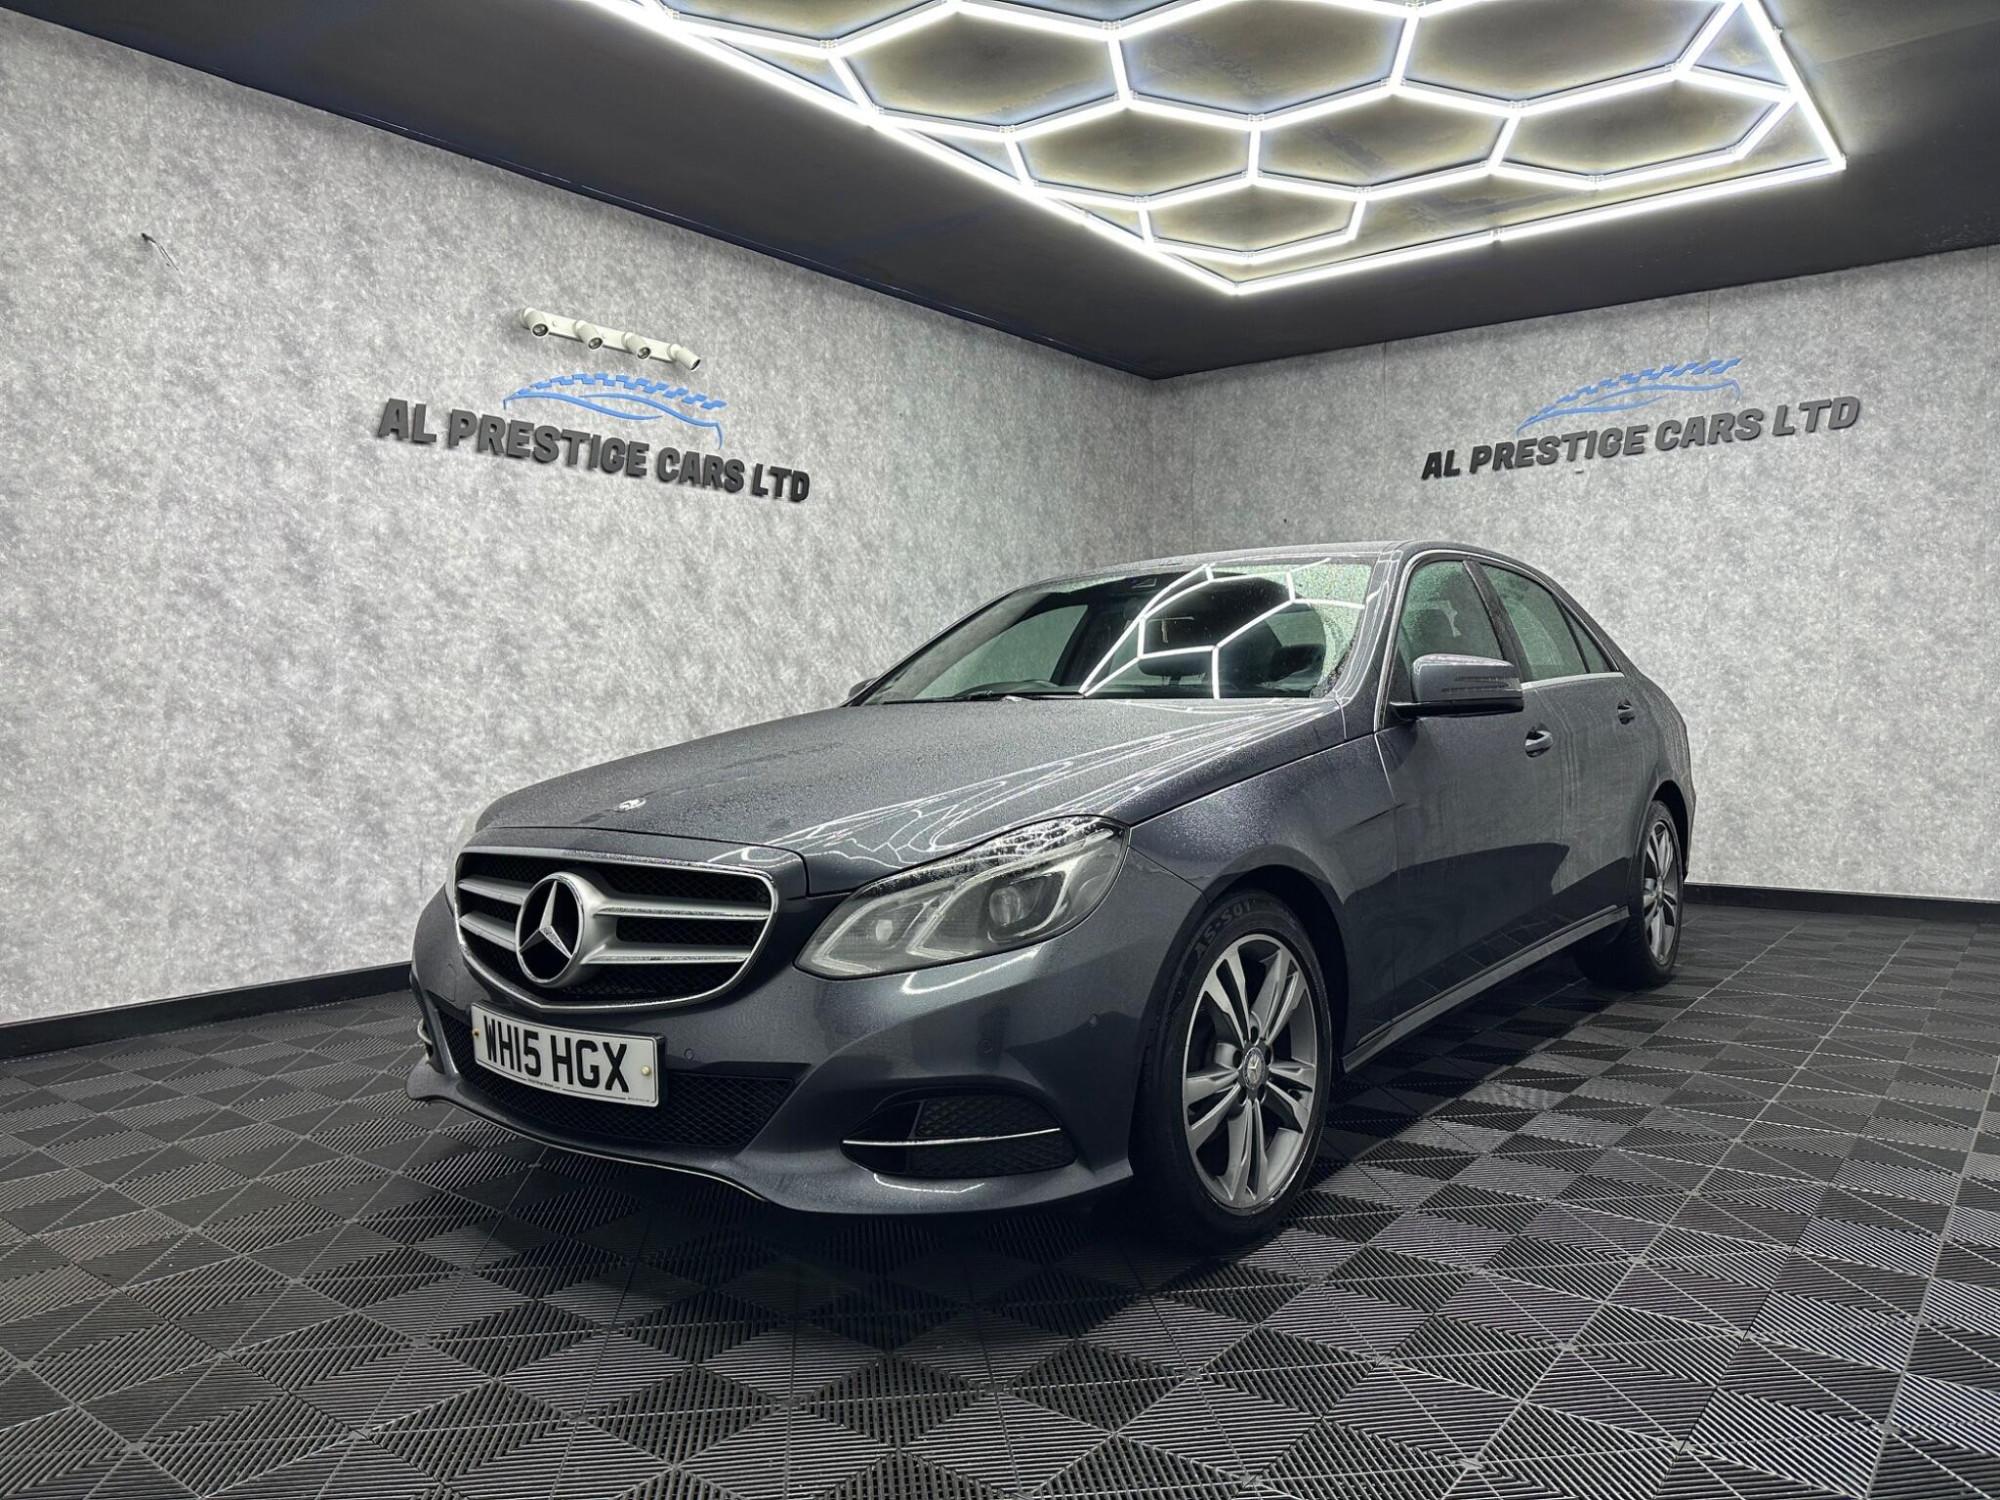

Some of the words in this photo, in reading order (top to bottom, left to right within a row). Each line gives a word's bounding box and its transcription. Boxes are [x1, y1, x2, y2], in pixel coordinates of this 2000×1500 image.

[379, 398, 437, 443] AL
[448, 408, 650, 477] PRESTIGE
[656, 447, 745, 493] CARS
[750, 463, 810, 502] LTD
[1421, 451, 1461, 480] AL
[1469, 425, 1649, 475] PRESTIGE
[1654, 408, 1764, 452] CARS
[1772, 396, 1860, 437] LTD
[483, 1015, 541, 1077] WH15
[550, 1034, 630, 1093] HGX
